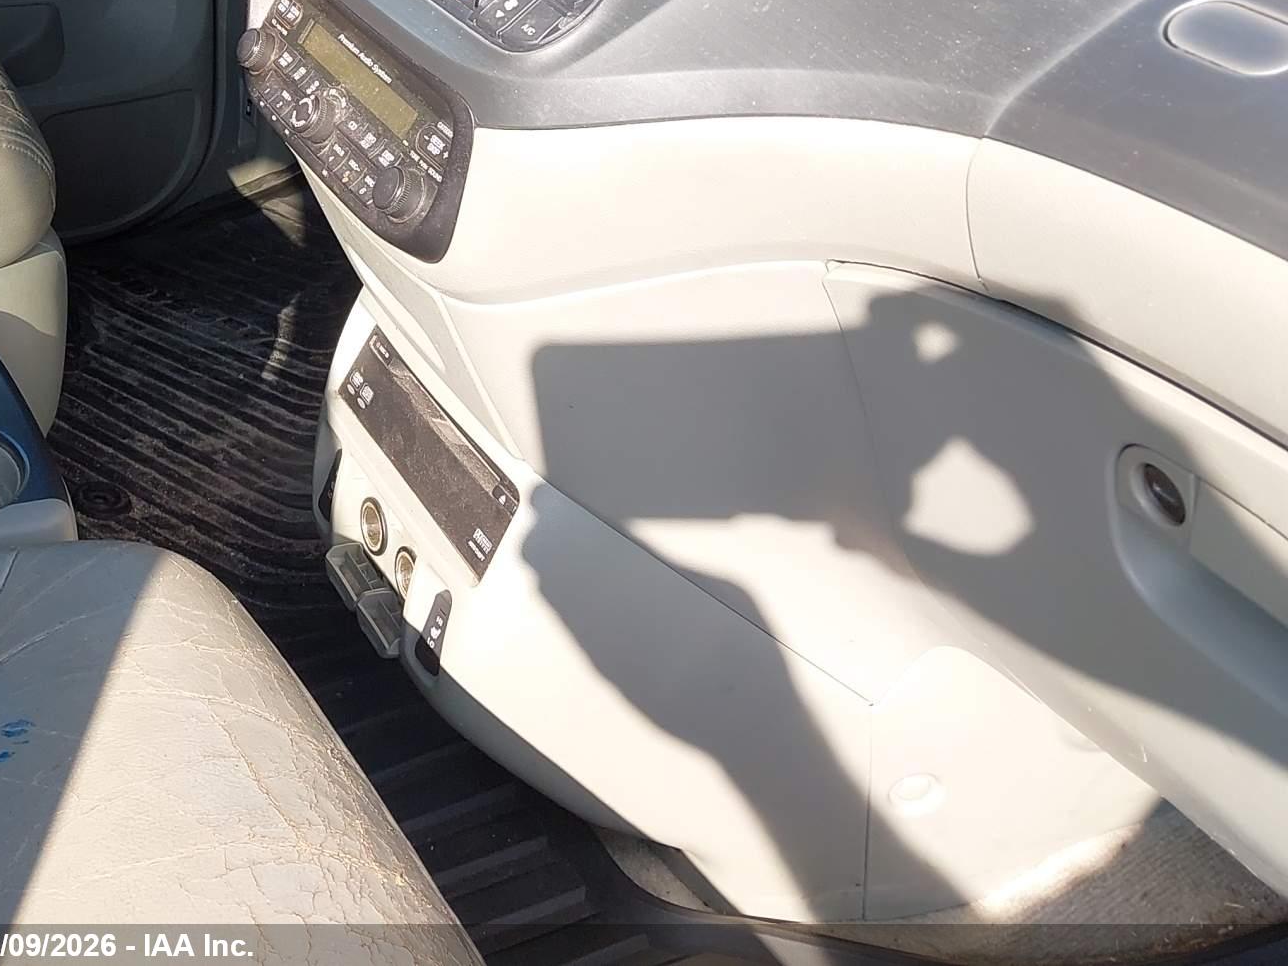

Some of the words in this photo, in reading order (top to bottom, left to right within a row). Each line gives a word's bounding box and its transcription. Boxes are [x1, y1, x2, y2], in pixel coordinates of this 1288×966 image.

[520, 22, 536, 36] A/C
[337, 32, 361, 55] Premium
[357, 51, 374, 67] Audio
[369, 63, 393, 84] System
